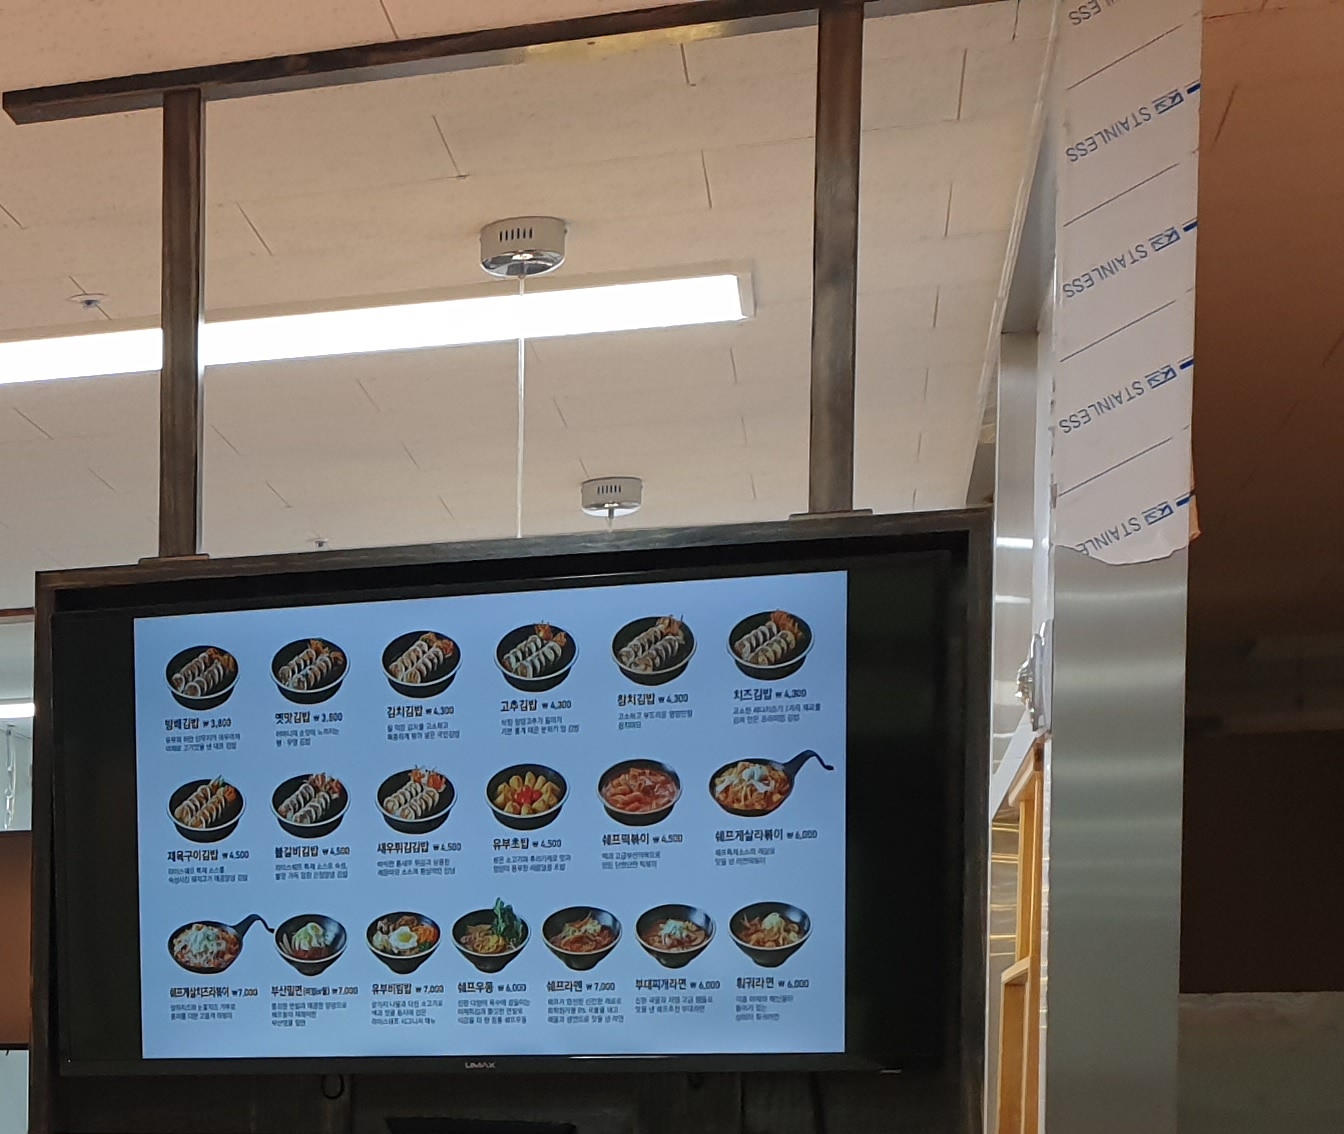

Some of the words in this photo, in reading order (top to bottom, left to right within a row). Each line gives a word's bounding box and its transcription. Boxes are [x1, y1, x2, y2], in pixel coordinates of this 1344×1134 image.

[1065, 106, 1152, 163] STAINLESS
[1062, 242, 1149, 299] STAINLESS
[1058, 378, 1146, 435] STAINLESS
[616, 692, 656, 707] 참치김밥
[732, 687, 773, 702] 치즈김밥
[386, 704, 424, 719] 김치김밥
[500, 699, 538, 713] 고추김밥
[492, 837, 530, 851] 유부초밥
